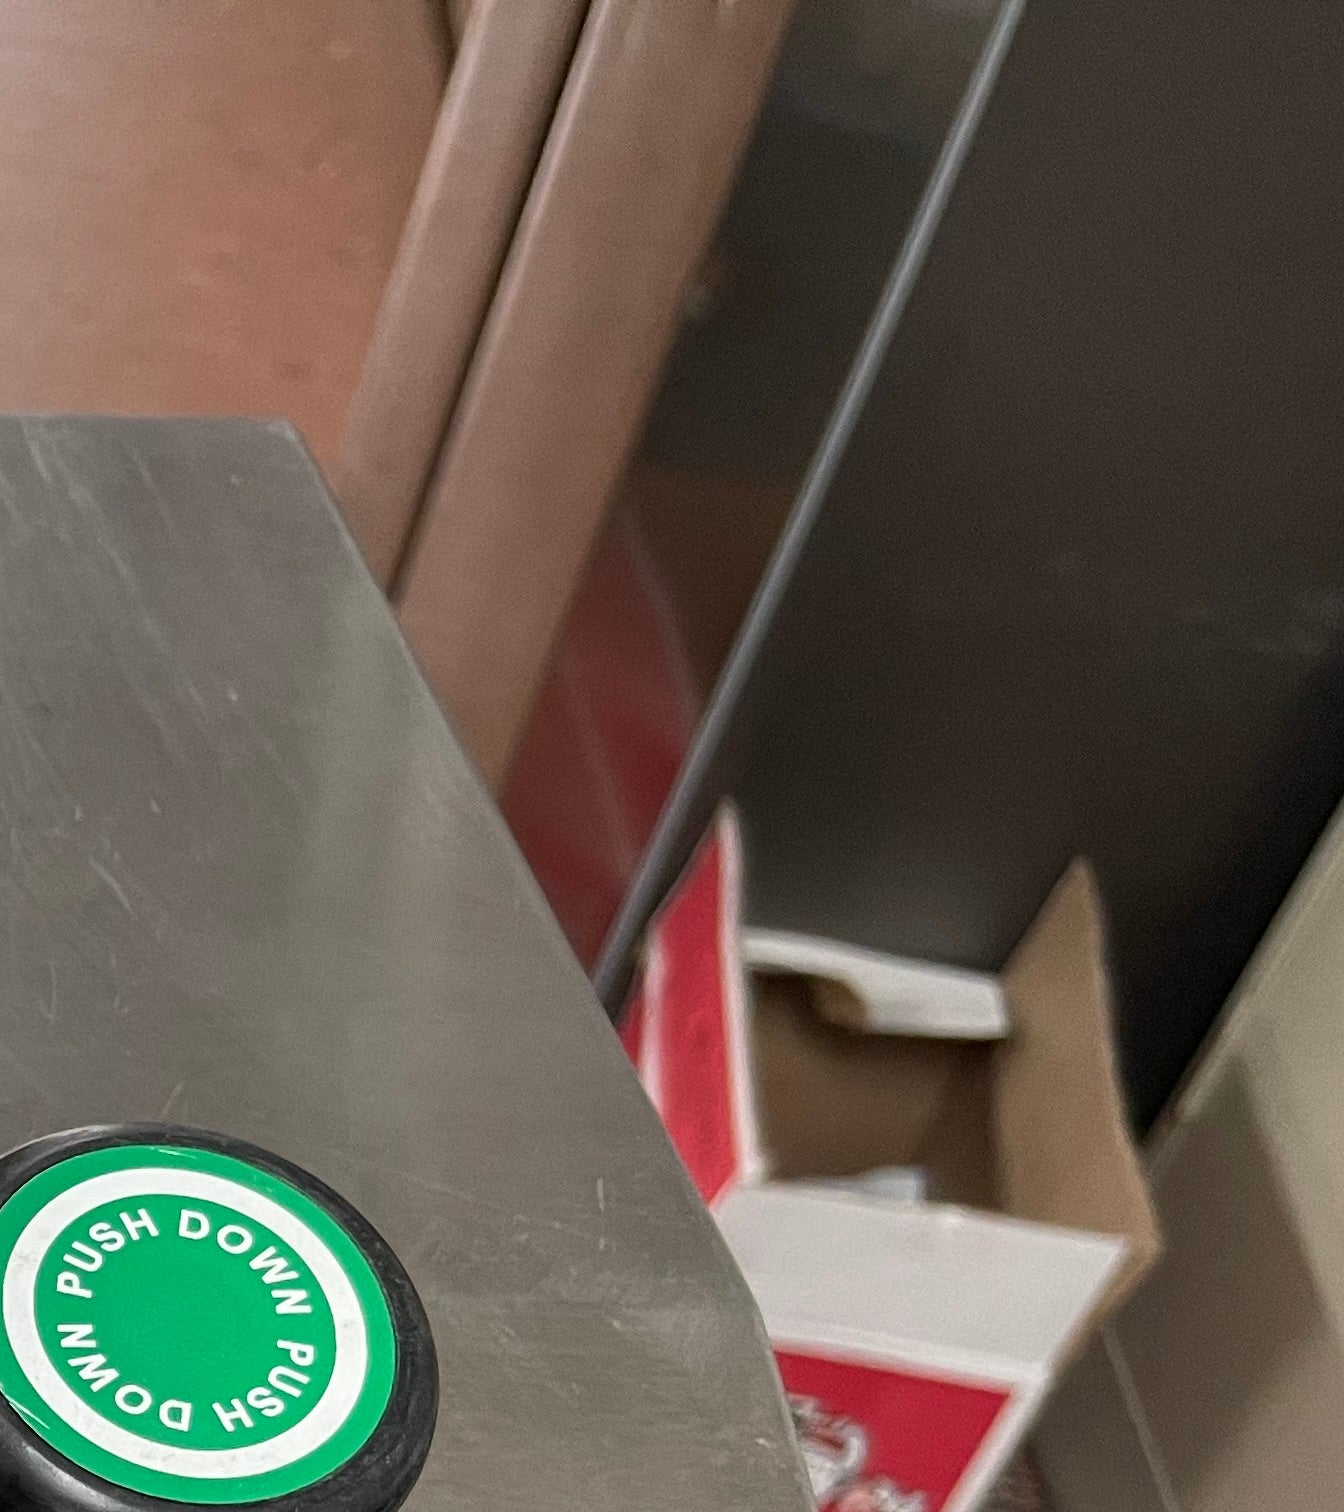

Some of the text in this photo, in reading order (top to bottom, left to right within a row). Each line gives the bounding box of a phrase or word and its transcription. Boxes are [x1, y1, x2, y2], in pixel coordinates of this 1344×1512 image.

[56, 1208, 316, 1433] PUSH DOWN PUSH DOWN
